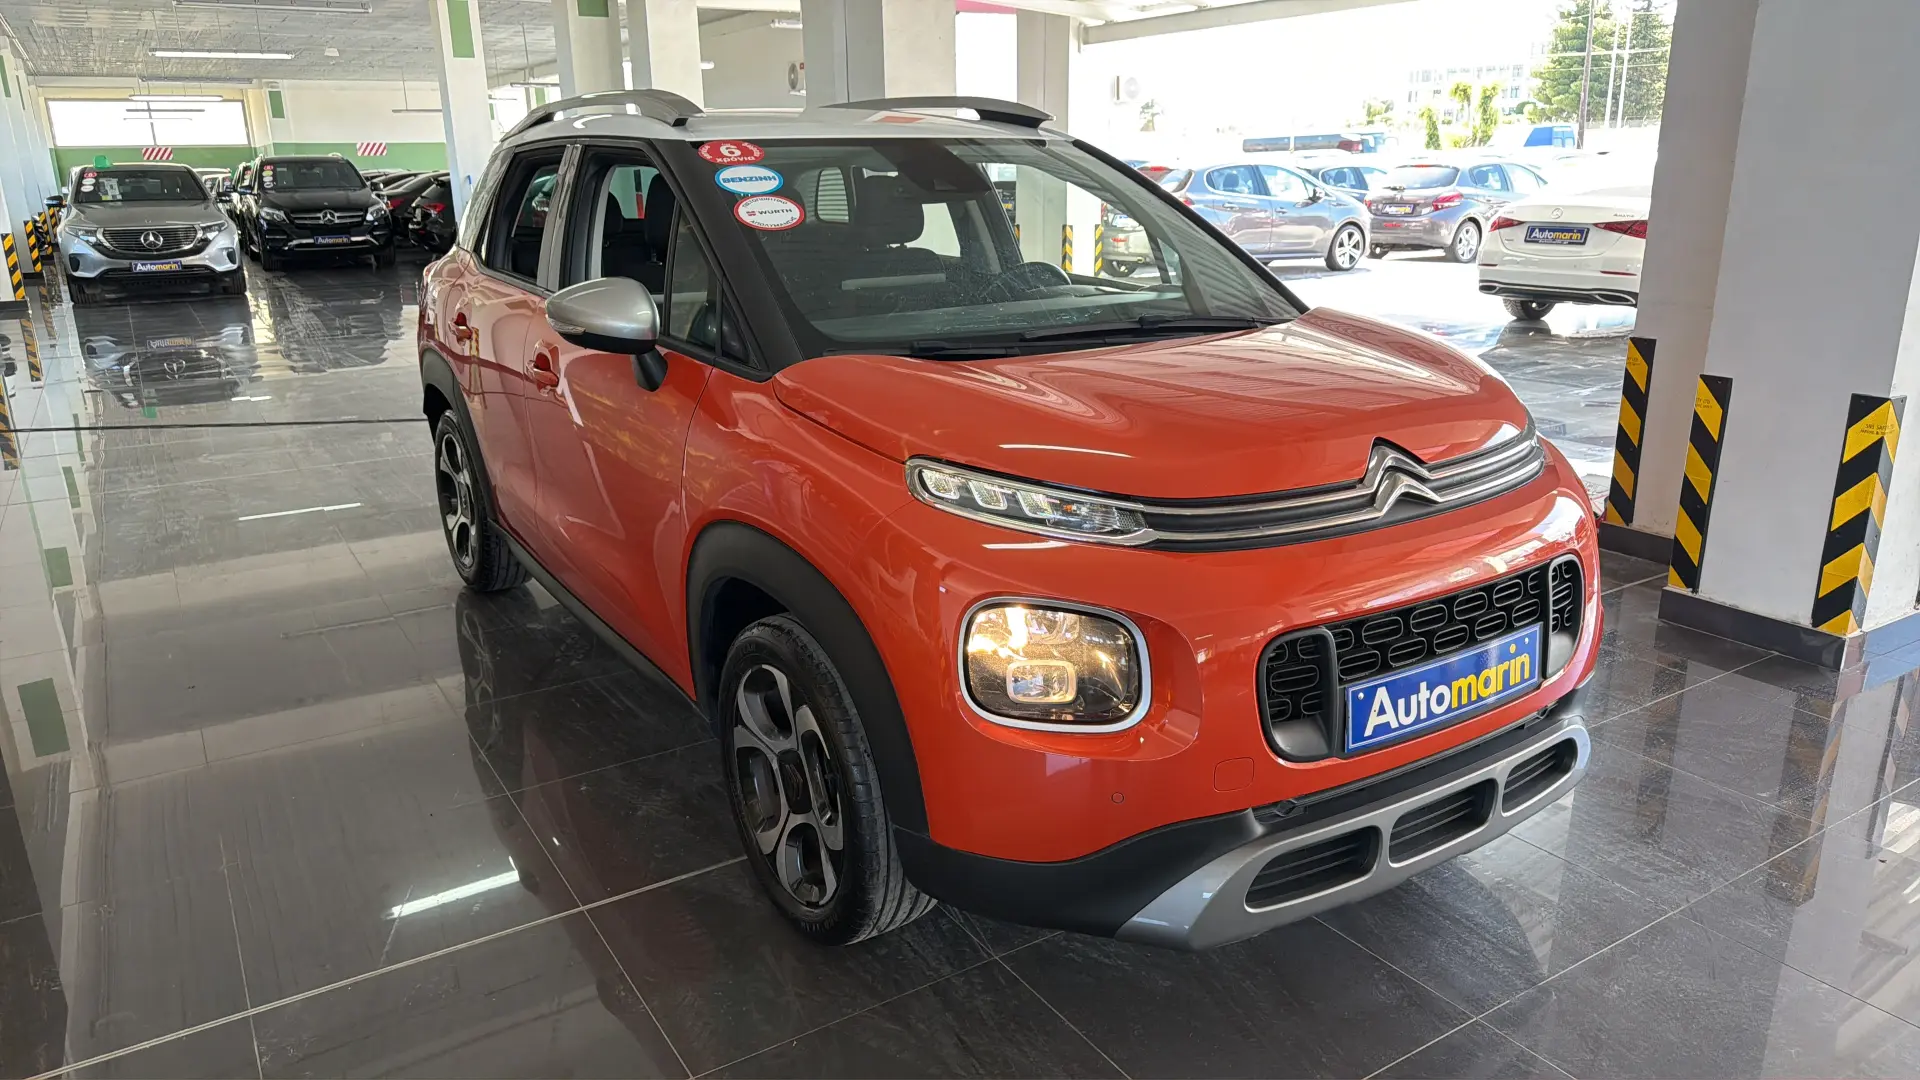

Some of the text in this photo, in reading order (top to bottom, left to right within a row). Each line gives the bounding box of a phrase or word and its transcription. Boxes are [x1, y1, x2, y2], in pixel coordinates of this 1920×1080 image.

[720, 145, 742, 157] 6
[317, 236, 349, 244] Automarin
[1531, 228, 1581, 241] Automarin
[136, 261, 178, 271] Automarin
[1364, 643, 1530, 737] Automarin
